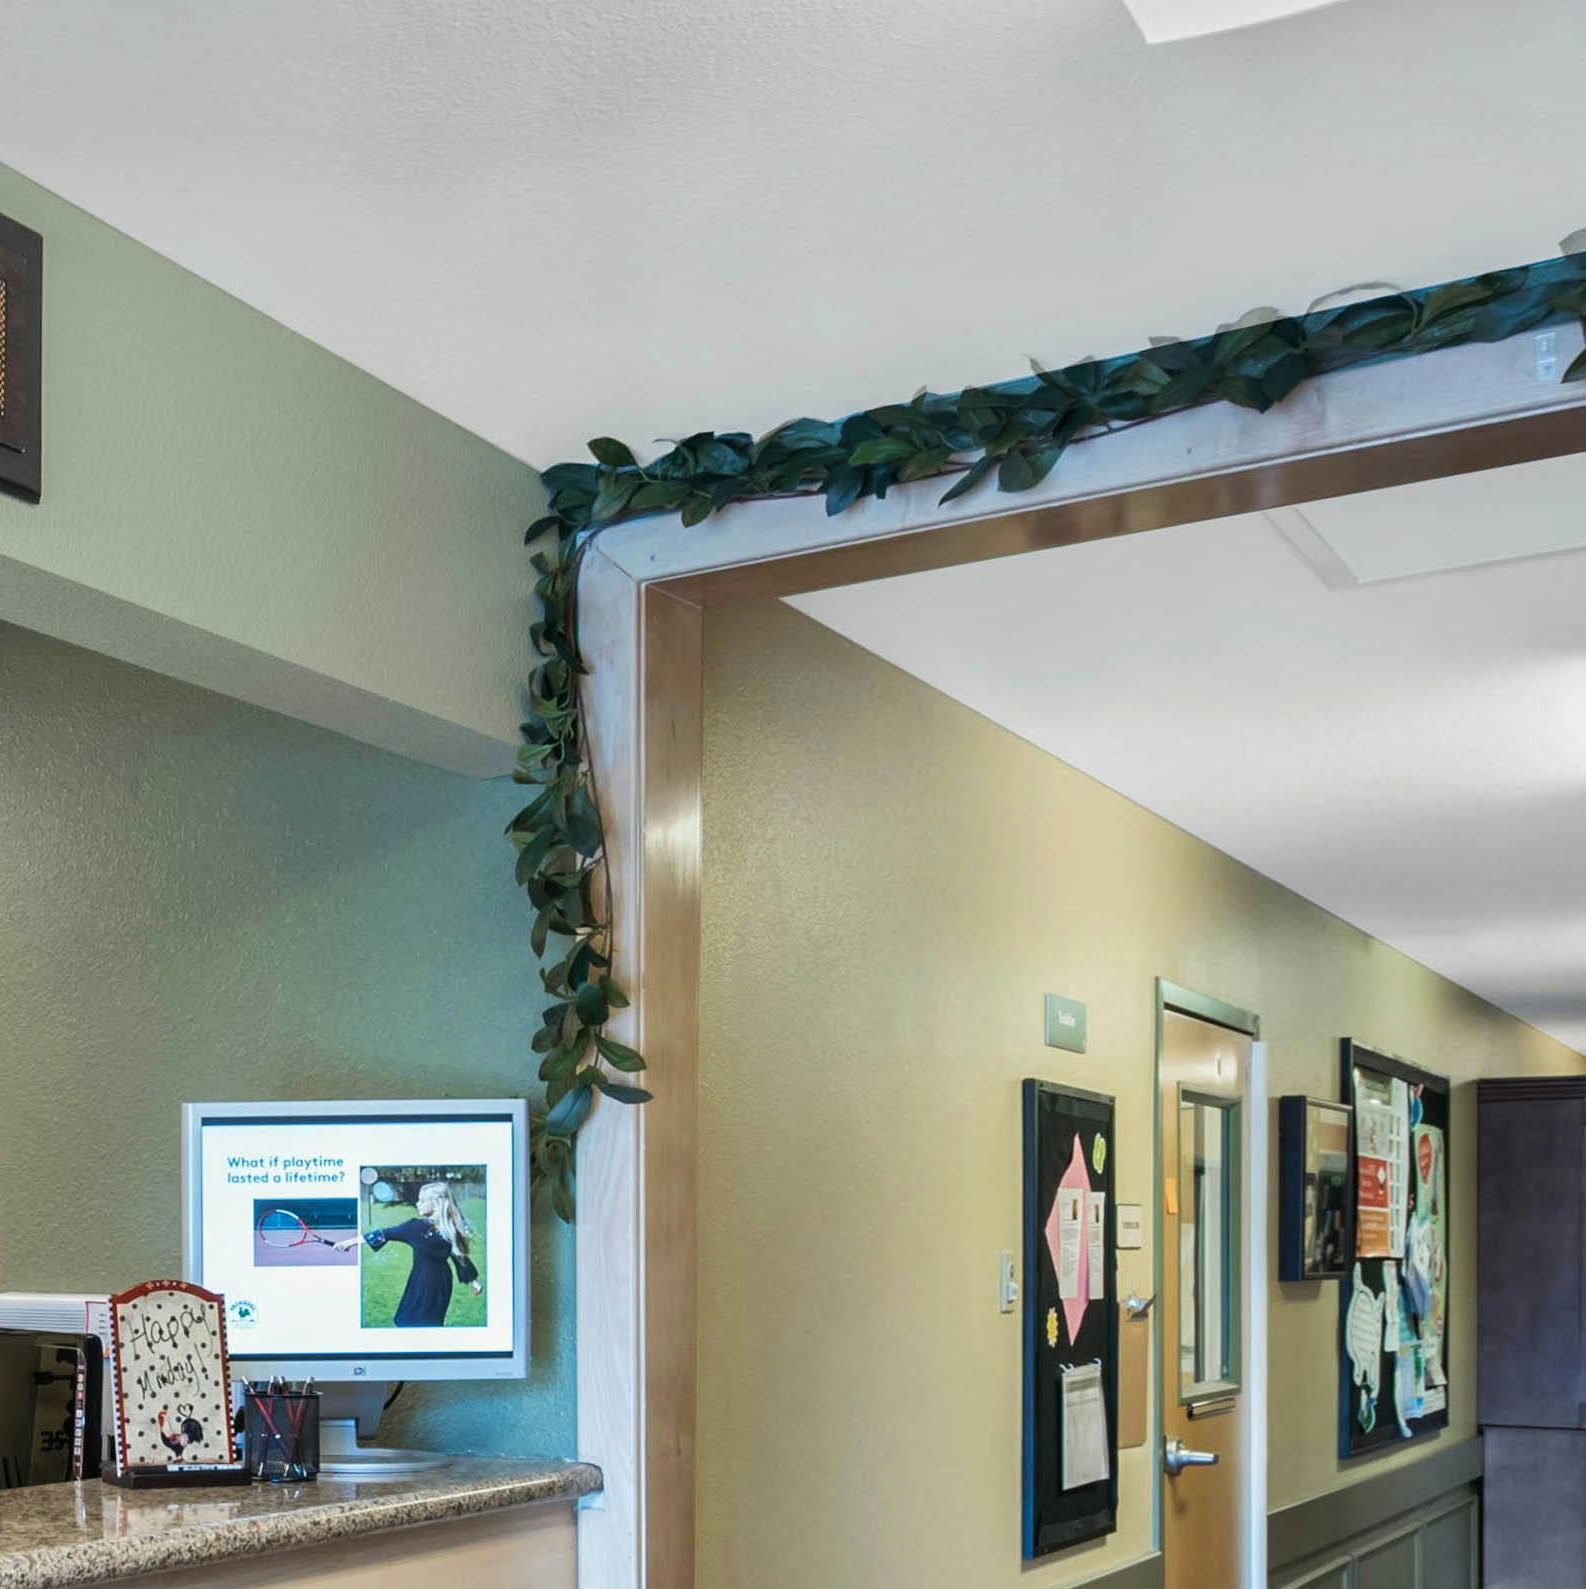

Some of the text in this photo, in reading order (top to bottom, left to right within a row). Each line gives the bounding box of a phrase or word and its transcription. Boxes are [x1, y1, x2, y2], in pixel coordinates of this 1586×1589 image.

[227, 1155, 344, 1170] What if playtime
[227, 1171, 345, 1184] lasted a lifetime?
[129, 1303, 214, 1361] Happy
